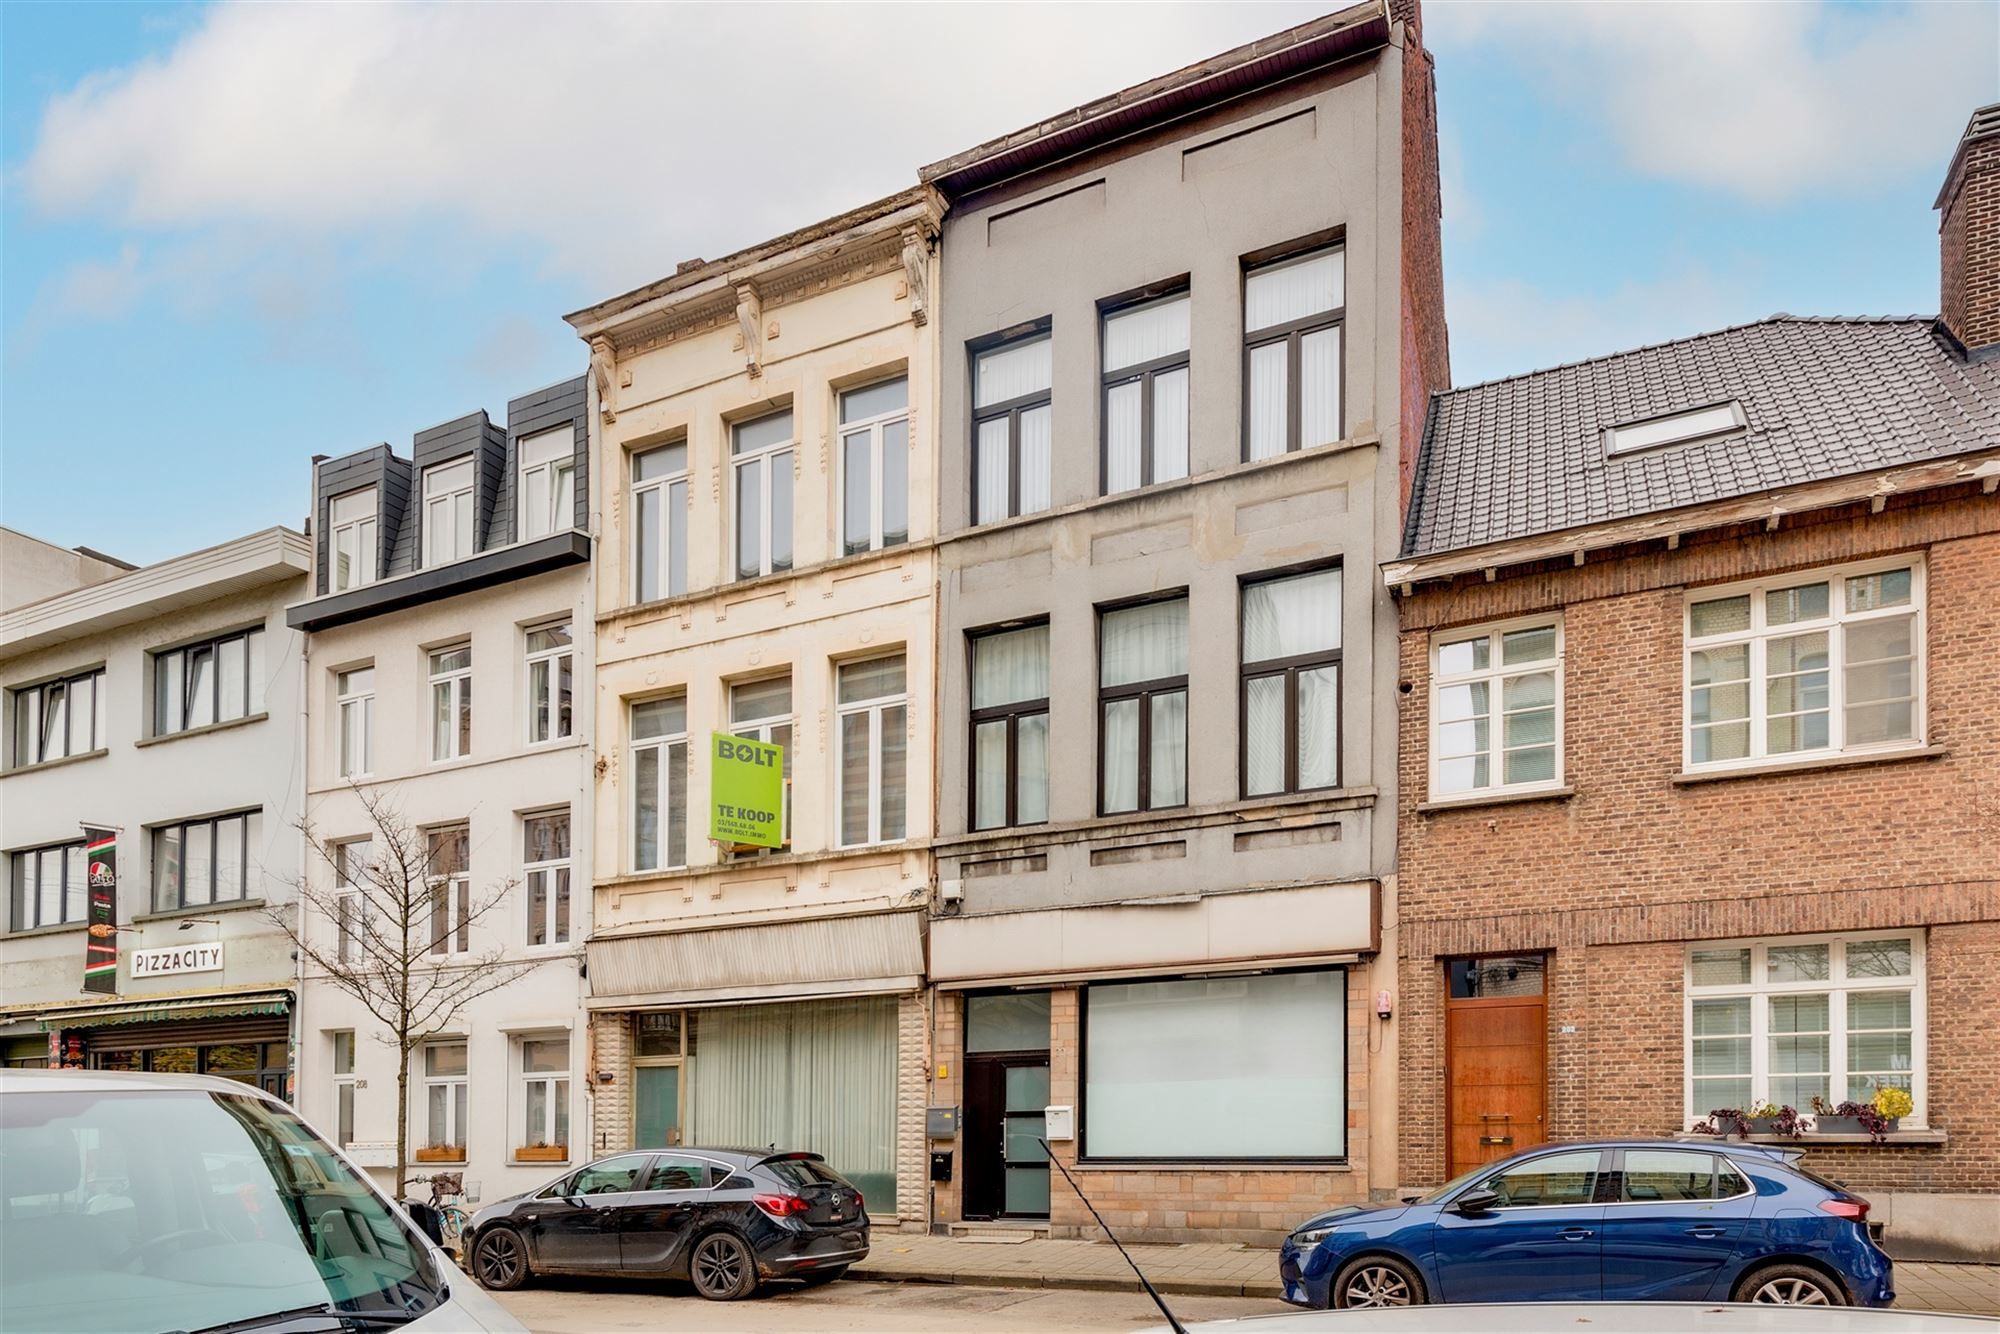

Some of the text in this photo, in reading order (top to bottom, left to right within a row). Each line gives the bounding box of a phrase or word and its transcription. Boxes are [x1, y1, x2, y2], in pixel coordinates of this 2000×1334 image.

[718, 739, 777, 767] BOLT
[717, 804, 775, 824] TE KOOP
[136, 948, 219, 973] PIZZACITY
